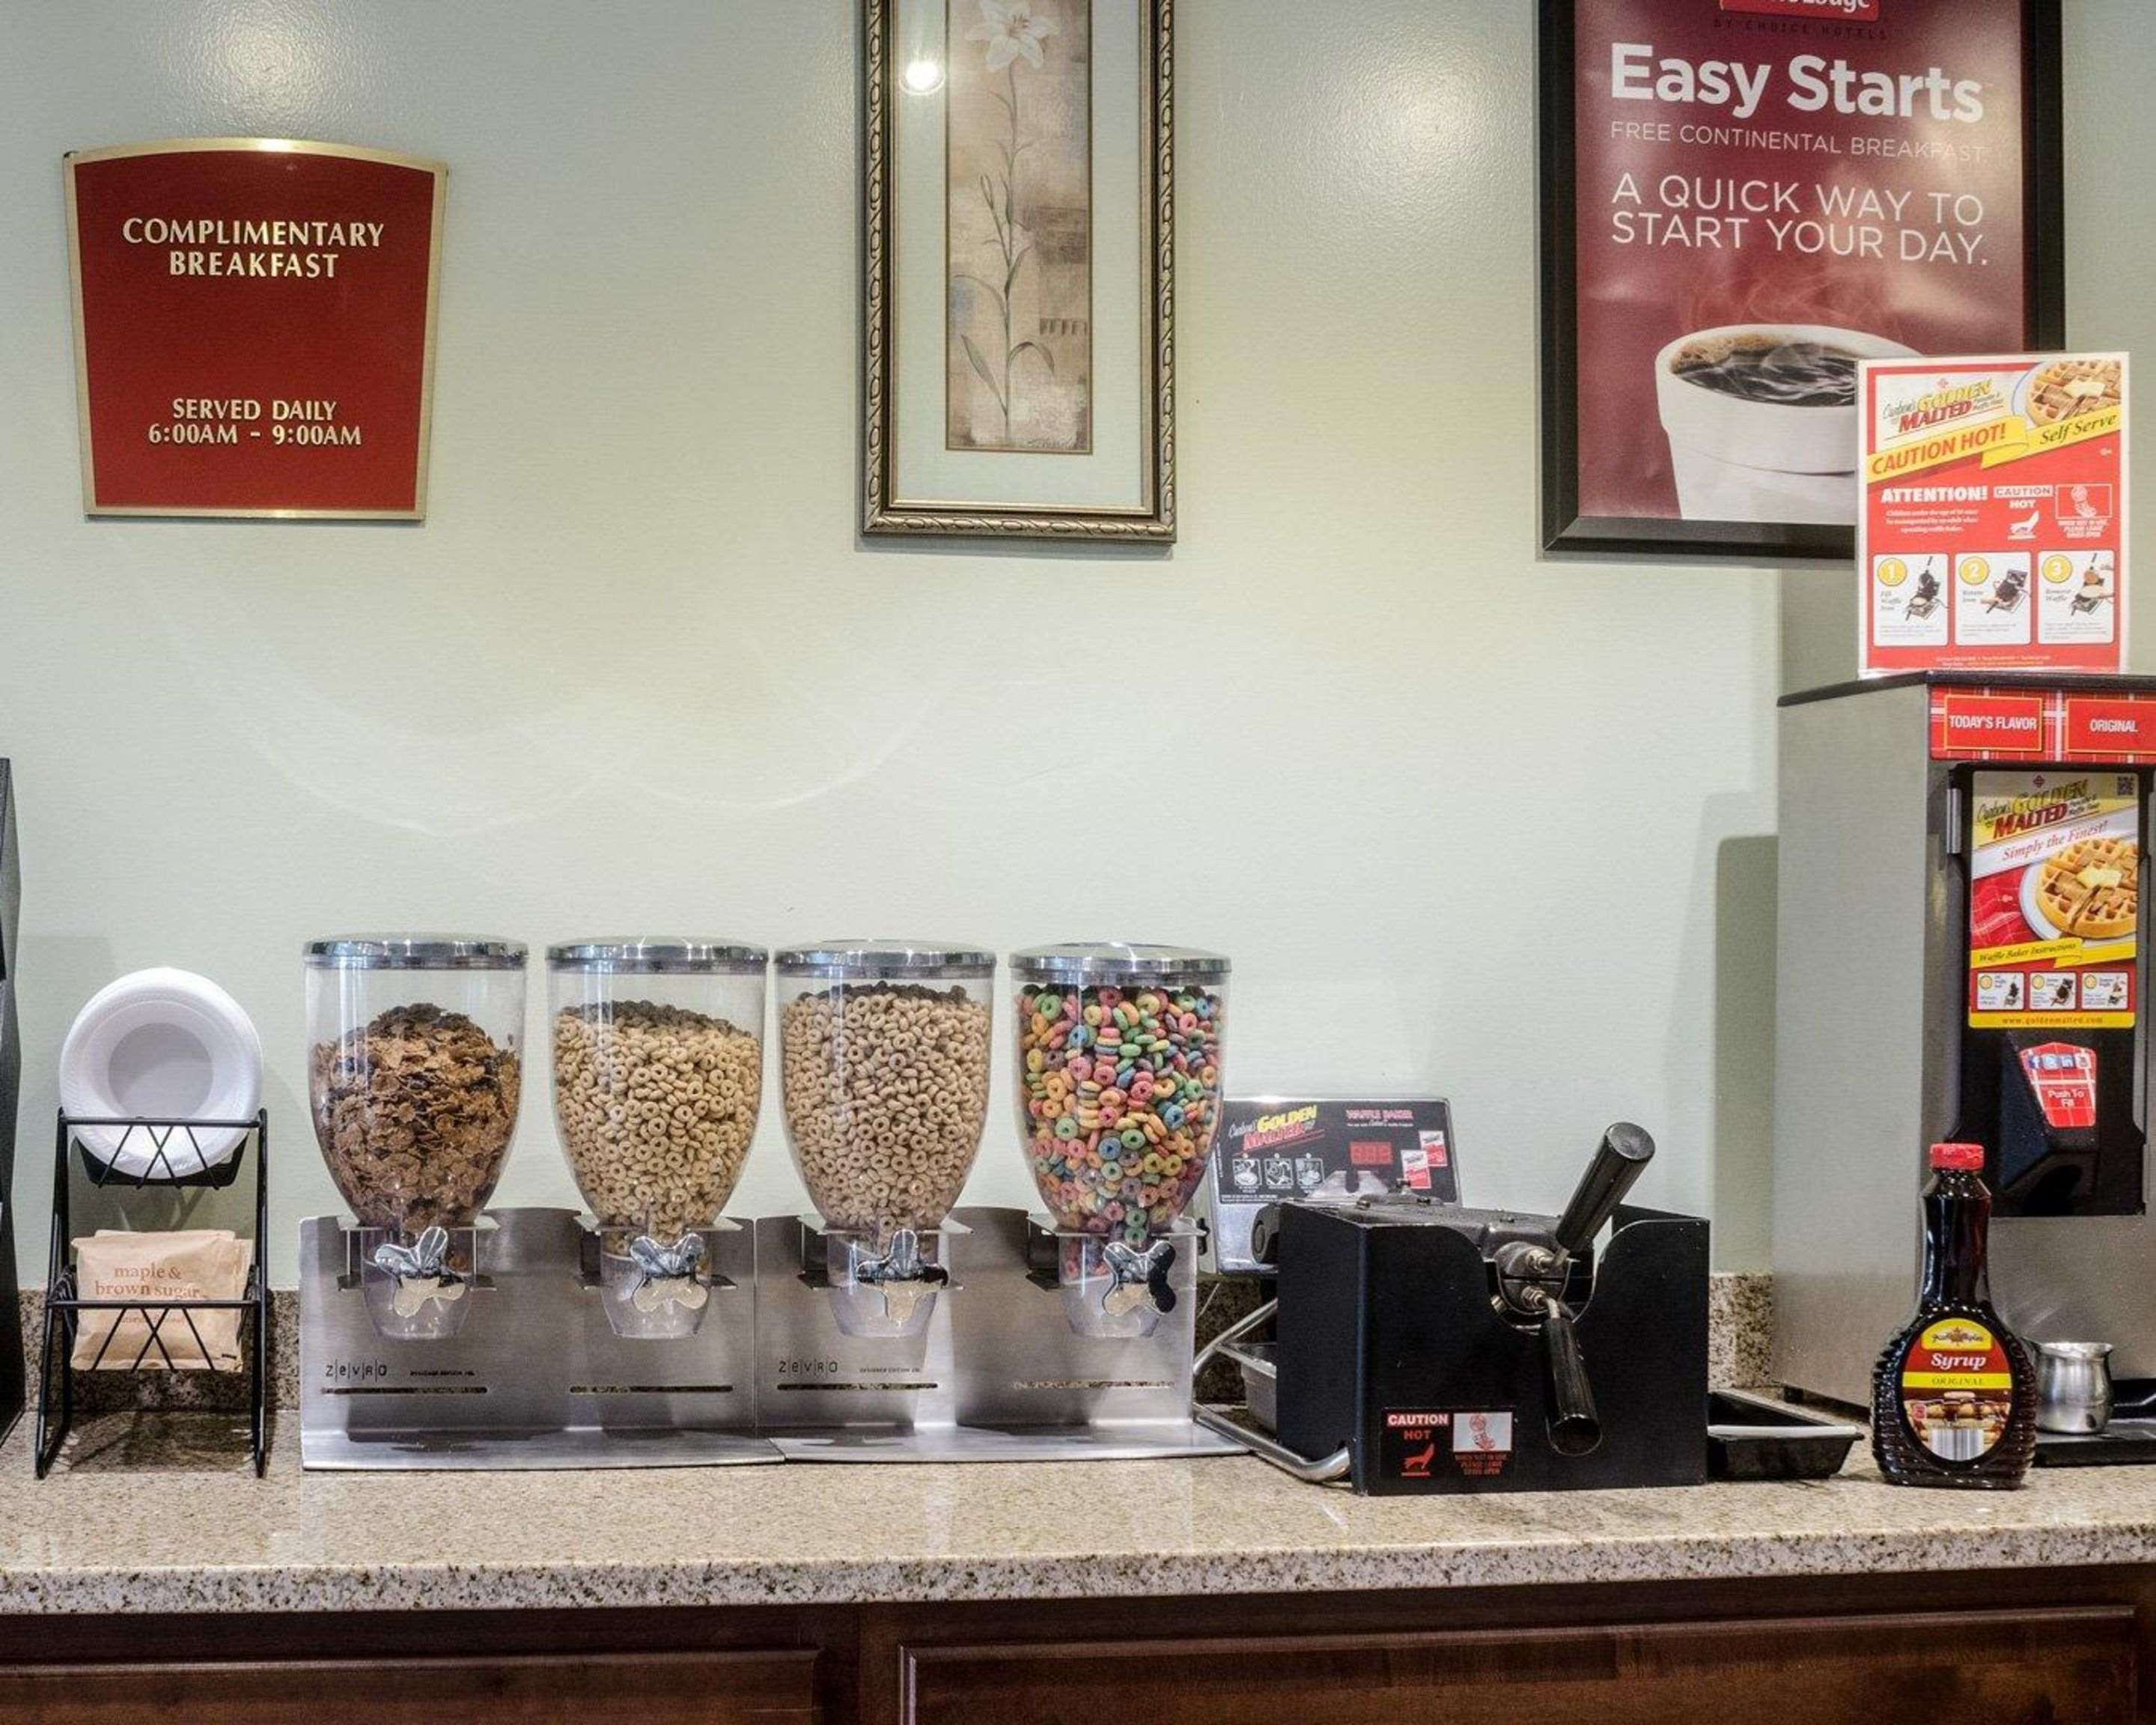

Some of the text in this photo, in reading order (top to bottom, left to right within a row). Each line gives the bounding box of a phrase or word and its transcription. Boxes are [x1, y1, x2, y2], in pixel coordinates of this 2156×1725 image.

[1611, 42, 1985, 123] Easy Starts
[1611, 121, 1671, 142] FREE
[1679, 125, 1842, 154] CONTINENTAL
[1612, 173, 1984, 226] A QUICK WAY TO
[123, 218, 384, 247] COMPLIMENTARY
[1612, 211, 1988, 267] START YOUR DAY.
[170, 251, 339, 278] BREAKFAST
[173, 398, 337, 422] SERVED DAILY
[1898, 401, 1973, 433] MALTED
[149, 424, 238, 444] 6:00AM
[272, 425, 362, 445] 9:00AM
[2039, 413, 2117, 445] Self Serve
[1872, 423, 2006, 475] CAUTION HOT!
[1881, 486, 2052, 503] ATTENTION! CAUTION
[2009, 499, 2036, 508] HOT
[1887, 564, 1896, 580] 1
[1969, 562, 1979, 578] 2
[2051, 561, 2062, 576] 3
[1949, 715, 2037, 730] TODAY'S FLAVOR
[2089, 719, 2138, 732] ORIGINAL
[1994, 803, 2068, 839] MALTED
[2003, 840, 2044, 860] Simply
[2047, 835, 2062, 847] the
[2047, 1089, 2084, 1098] Push To
[1258, 1104, 1317, 1133] GOLDEN
[114, 1262, 183, 1280] maple &
[95, 1280, 150, 1296] brown
[1931, 1353, 1986, 1371] Syrup
[1388, 1414, 1449, 1426] CAUTION
[1404, 1430, 1431, 1440] HOT
